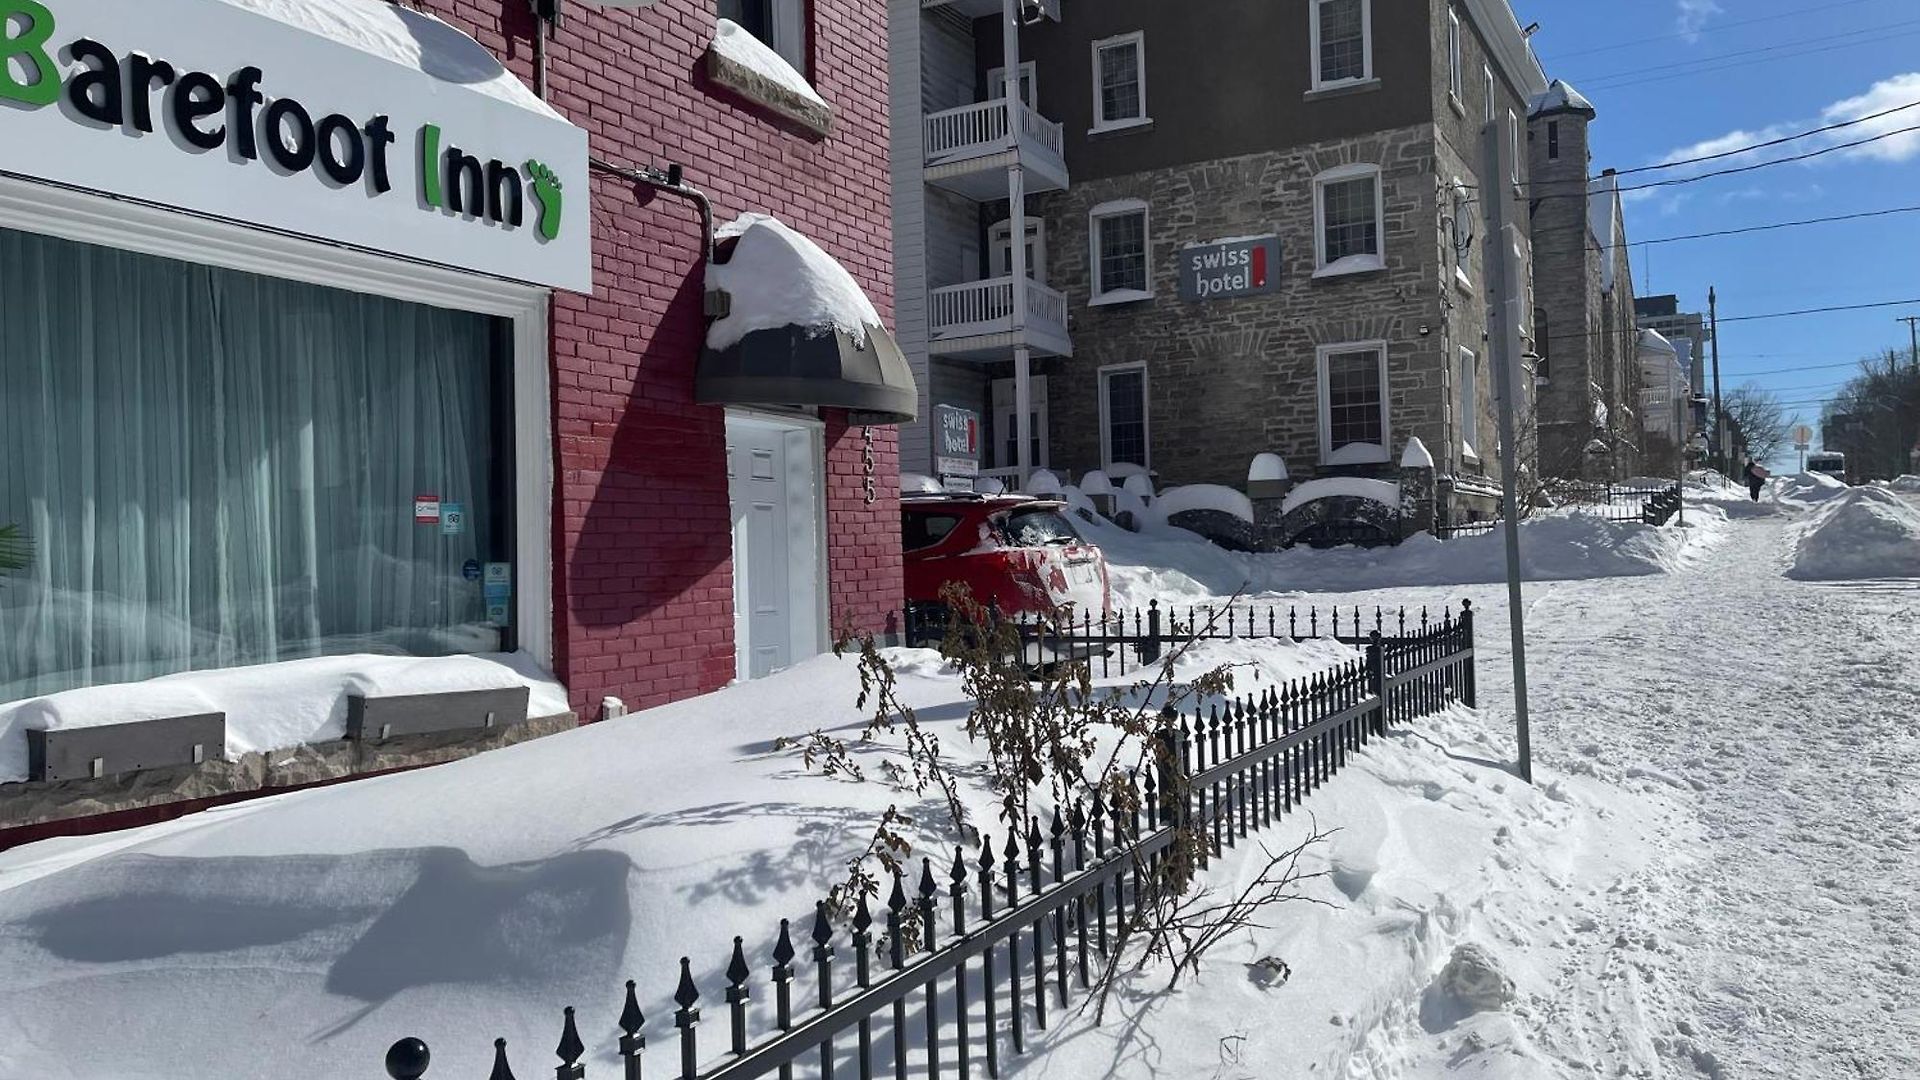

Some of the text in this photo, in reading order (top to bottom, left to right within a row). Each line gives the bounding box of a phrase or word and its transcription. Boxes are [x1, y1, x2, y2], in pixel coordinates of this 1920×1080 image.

[0, 0, 524, 228] Barefoot Inn
[1191, 245, 1250, 271] swiss
[1196, 266, 1249, 297] hotel
[943, 410, 968, 431] swiss
[945, 430, 969, 454] hotel
